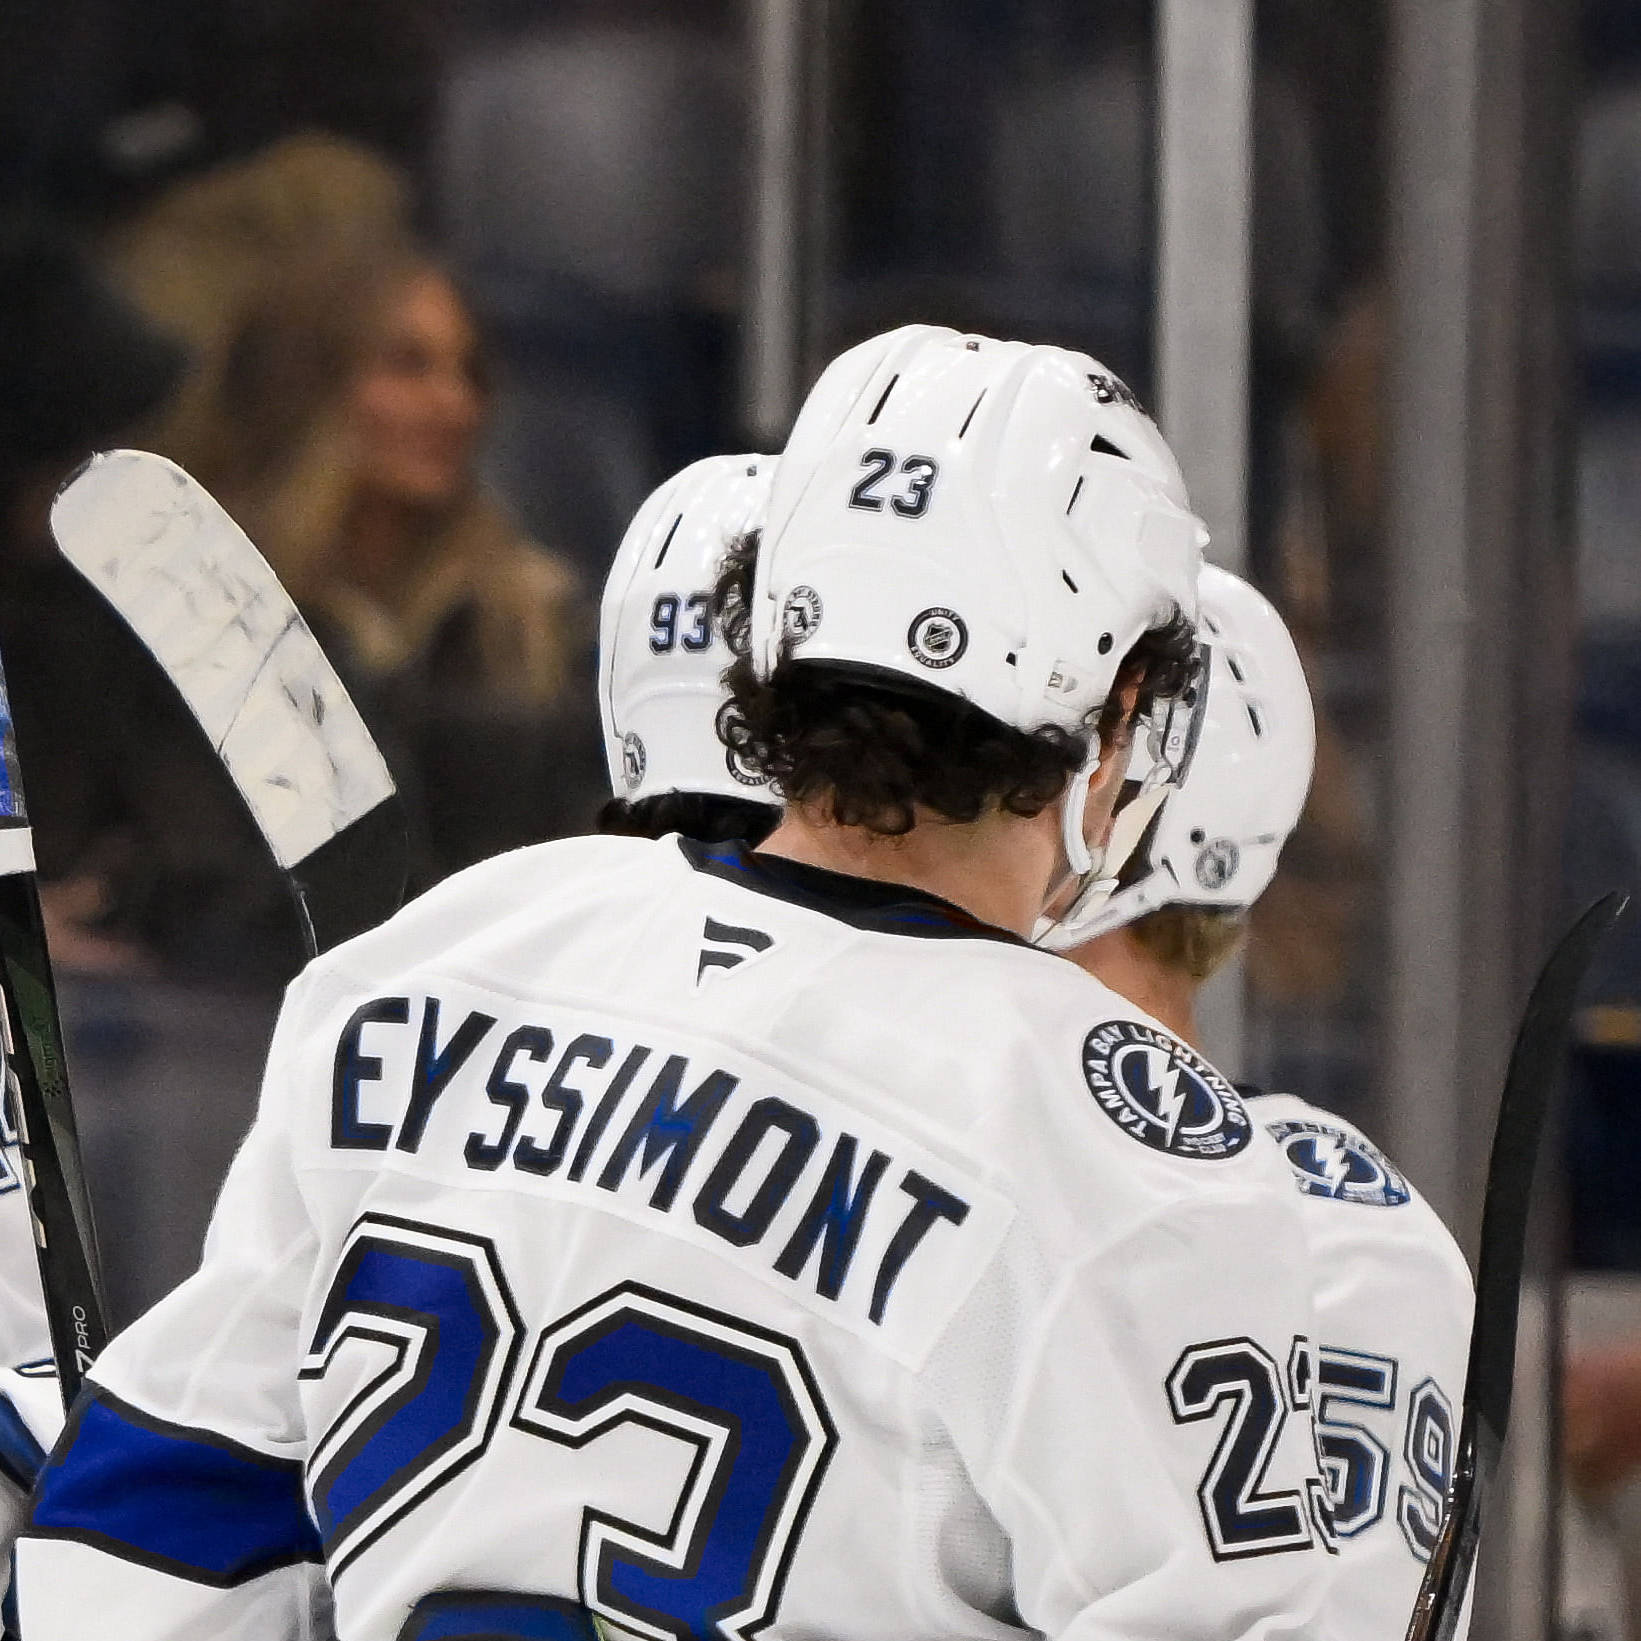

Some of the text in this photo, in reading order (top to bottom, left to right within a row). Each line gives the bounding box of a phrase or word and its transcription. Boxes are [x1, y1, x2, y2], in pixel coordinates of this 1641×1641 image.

[848, 447, 939, 519] 23
[649, 592, 715, 656] 93
[1089, 1024, 1126, 1056] BAY
[1086, 1059, 1147, 1138] TAMPA
[330, 995, 971, 1327] EYSSIMONT
[72, 1305, 92, 1350] PRO
